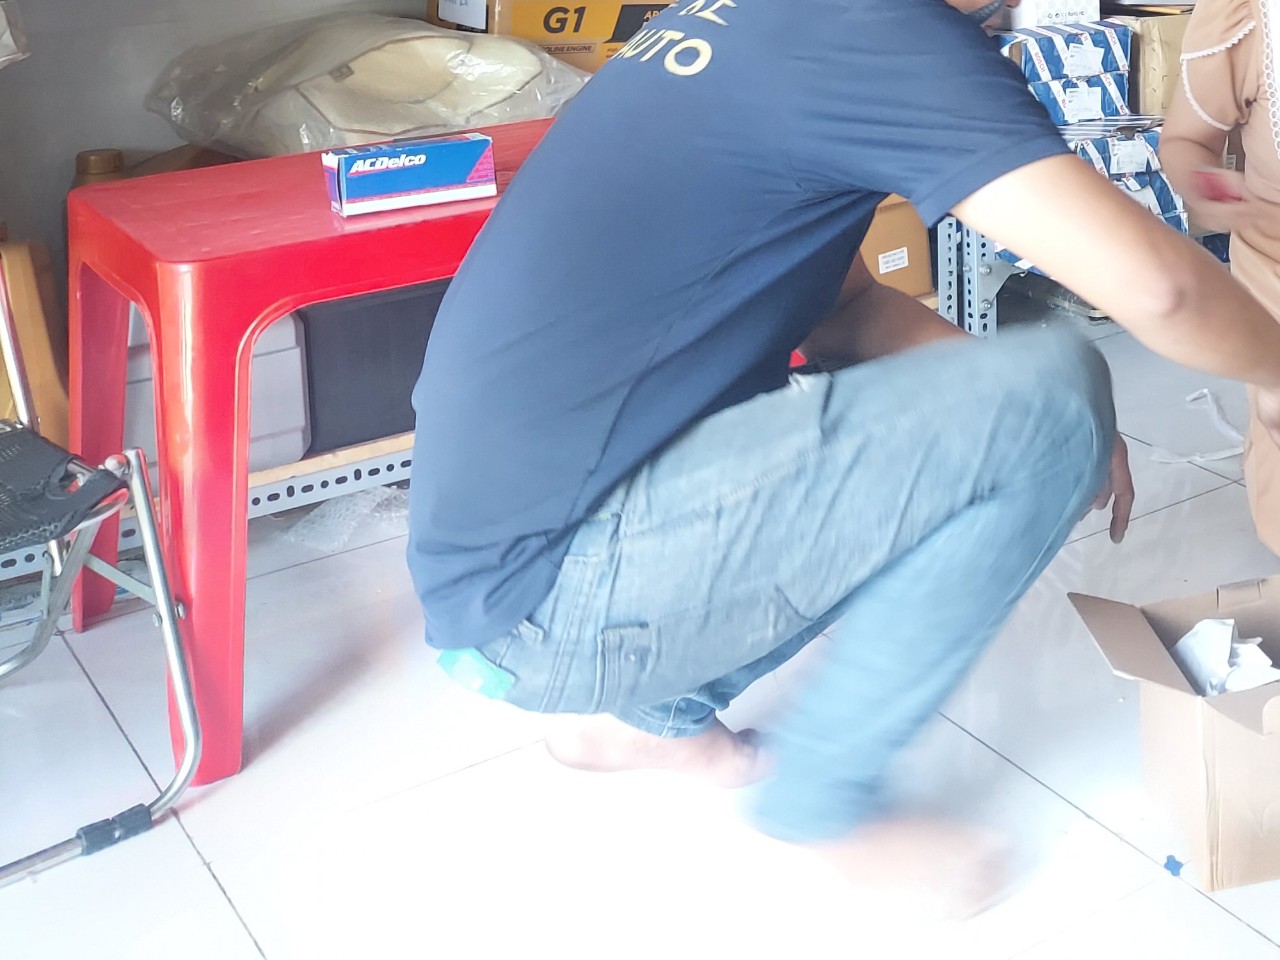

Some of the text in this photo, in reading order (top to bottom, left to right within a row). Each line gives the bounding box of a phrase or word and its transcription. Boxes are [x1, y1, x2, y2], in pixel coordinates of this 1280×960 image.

[543, 6, 587, 34] G1
[566, 44, 592, 53] ENGINE
[611, 29, 713, 76] AUTO
[350, 154, 427, 173] ACDelco
